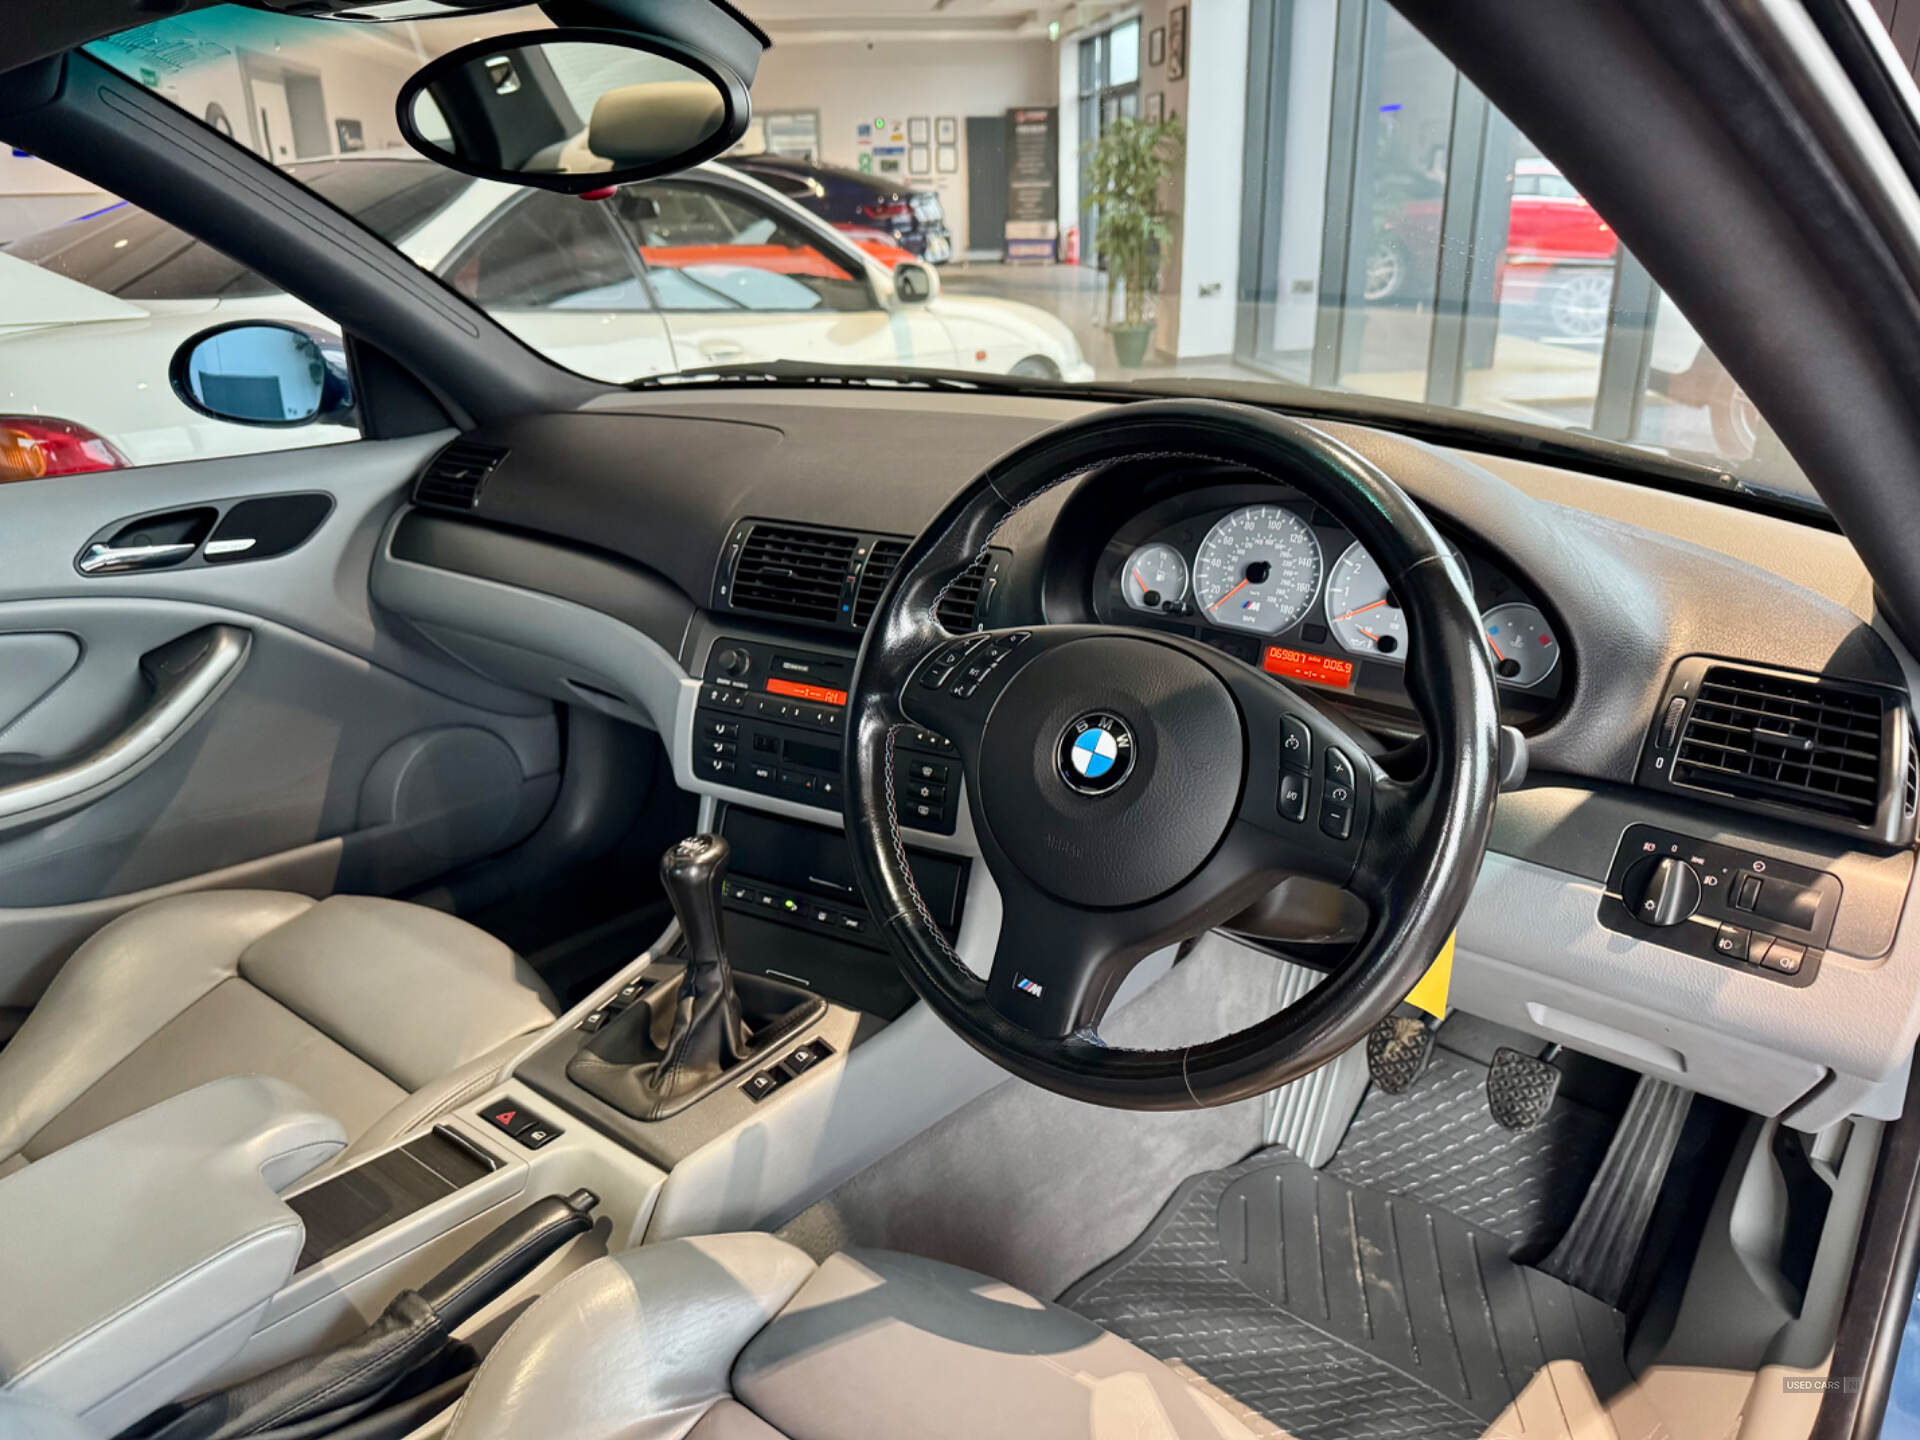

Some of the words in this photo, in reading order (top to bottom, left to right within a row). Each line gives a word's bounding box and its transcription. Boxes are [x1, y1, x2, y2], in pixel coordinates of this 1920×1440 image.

[1244, 522, 1255, 531] 80
[1268, 521, 1282, 530] 100
[1223, 537, 1234, 546] 60
[1290, 534, 1304, 544] 120
[1211, 558, 1222, 568] 40
[1298, 557, 1312, 567] 140
[1353, 562, 1362, 575] 2
[1210, 585, 1220, 594] 20
[1296, 583, 1310, 593] 160
[1344, 586, 1350, 597] 1
[1280, 604, 1294, 614] 180
[1075, 716, 1131, 748] BMW
